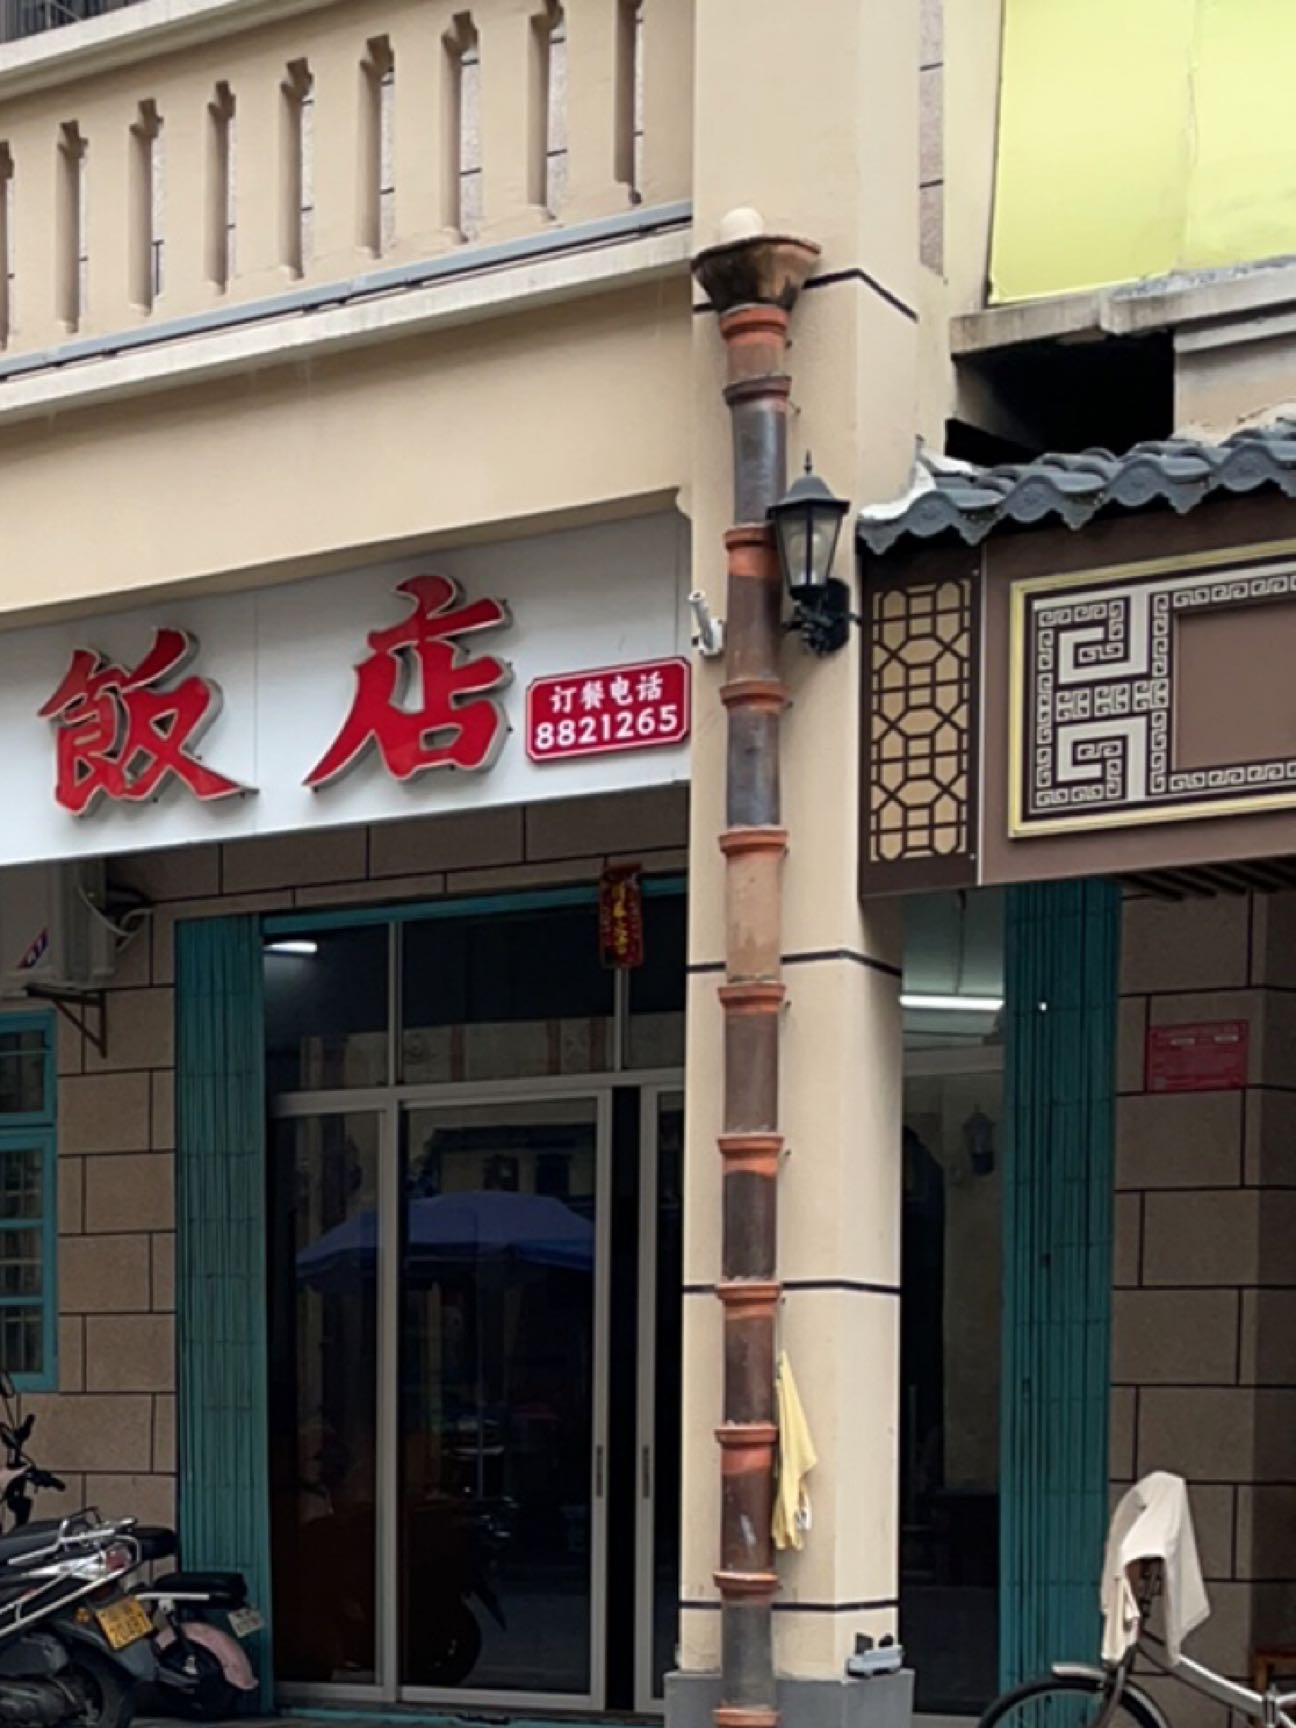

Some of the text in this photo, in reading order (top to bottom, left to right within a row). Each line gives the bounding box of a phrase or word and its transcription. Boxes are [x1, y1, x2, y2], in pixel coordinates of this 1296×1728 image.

[550, 671, 664, 714] 订餐电话
[535, 704, 678, 750] 8821265
